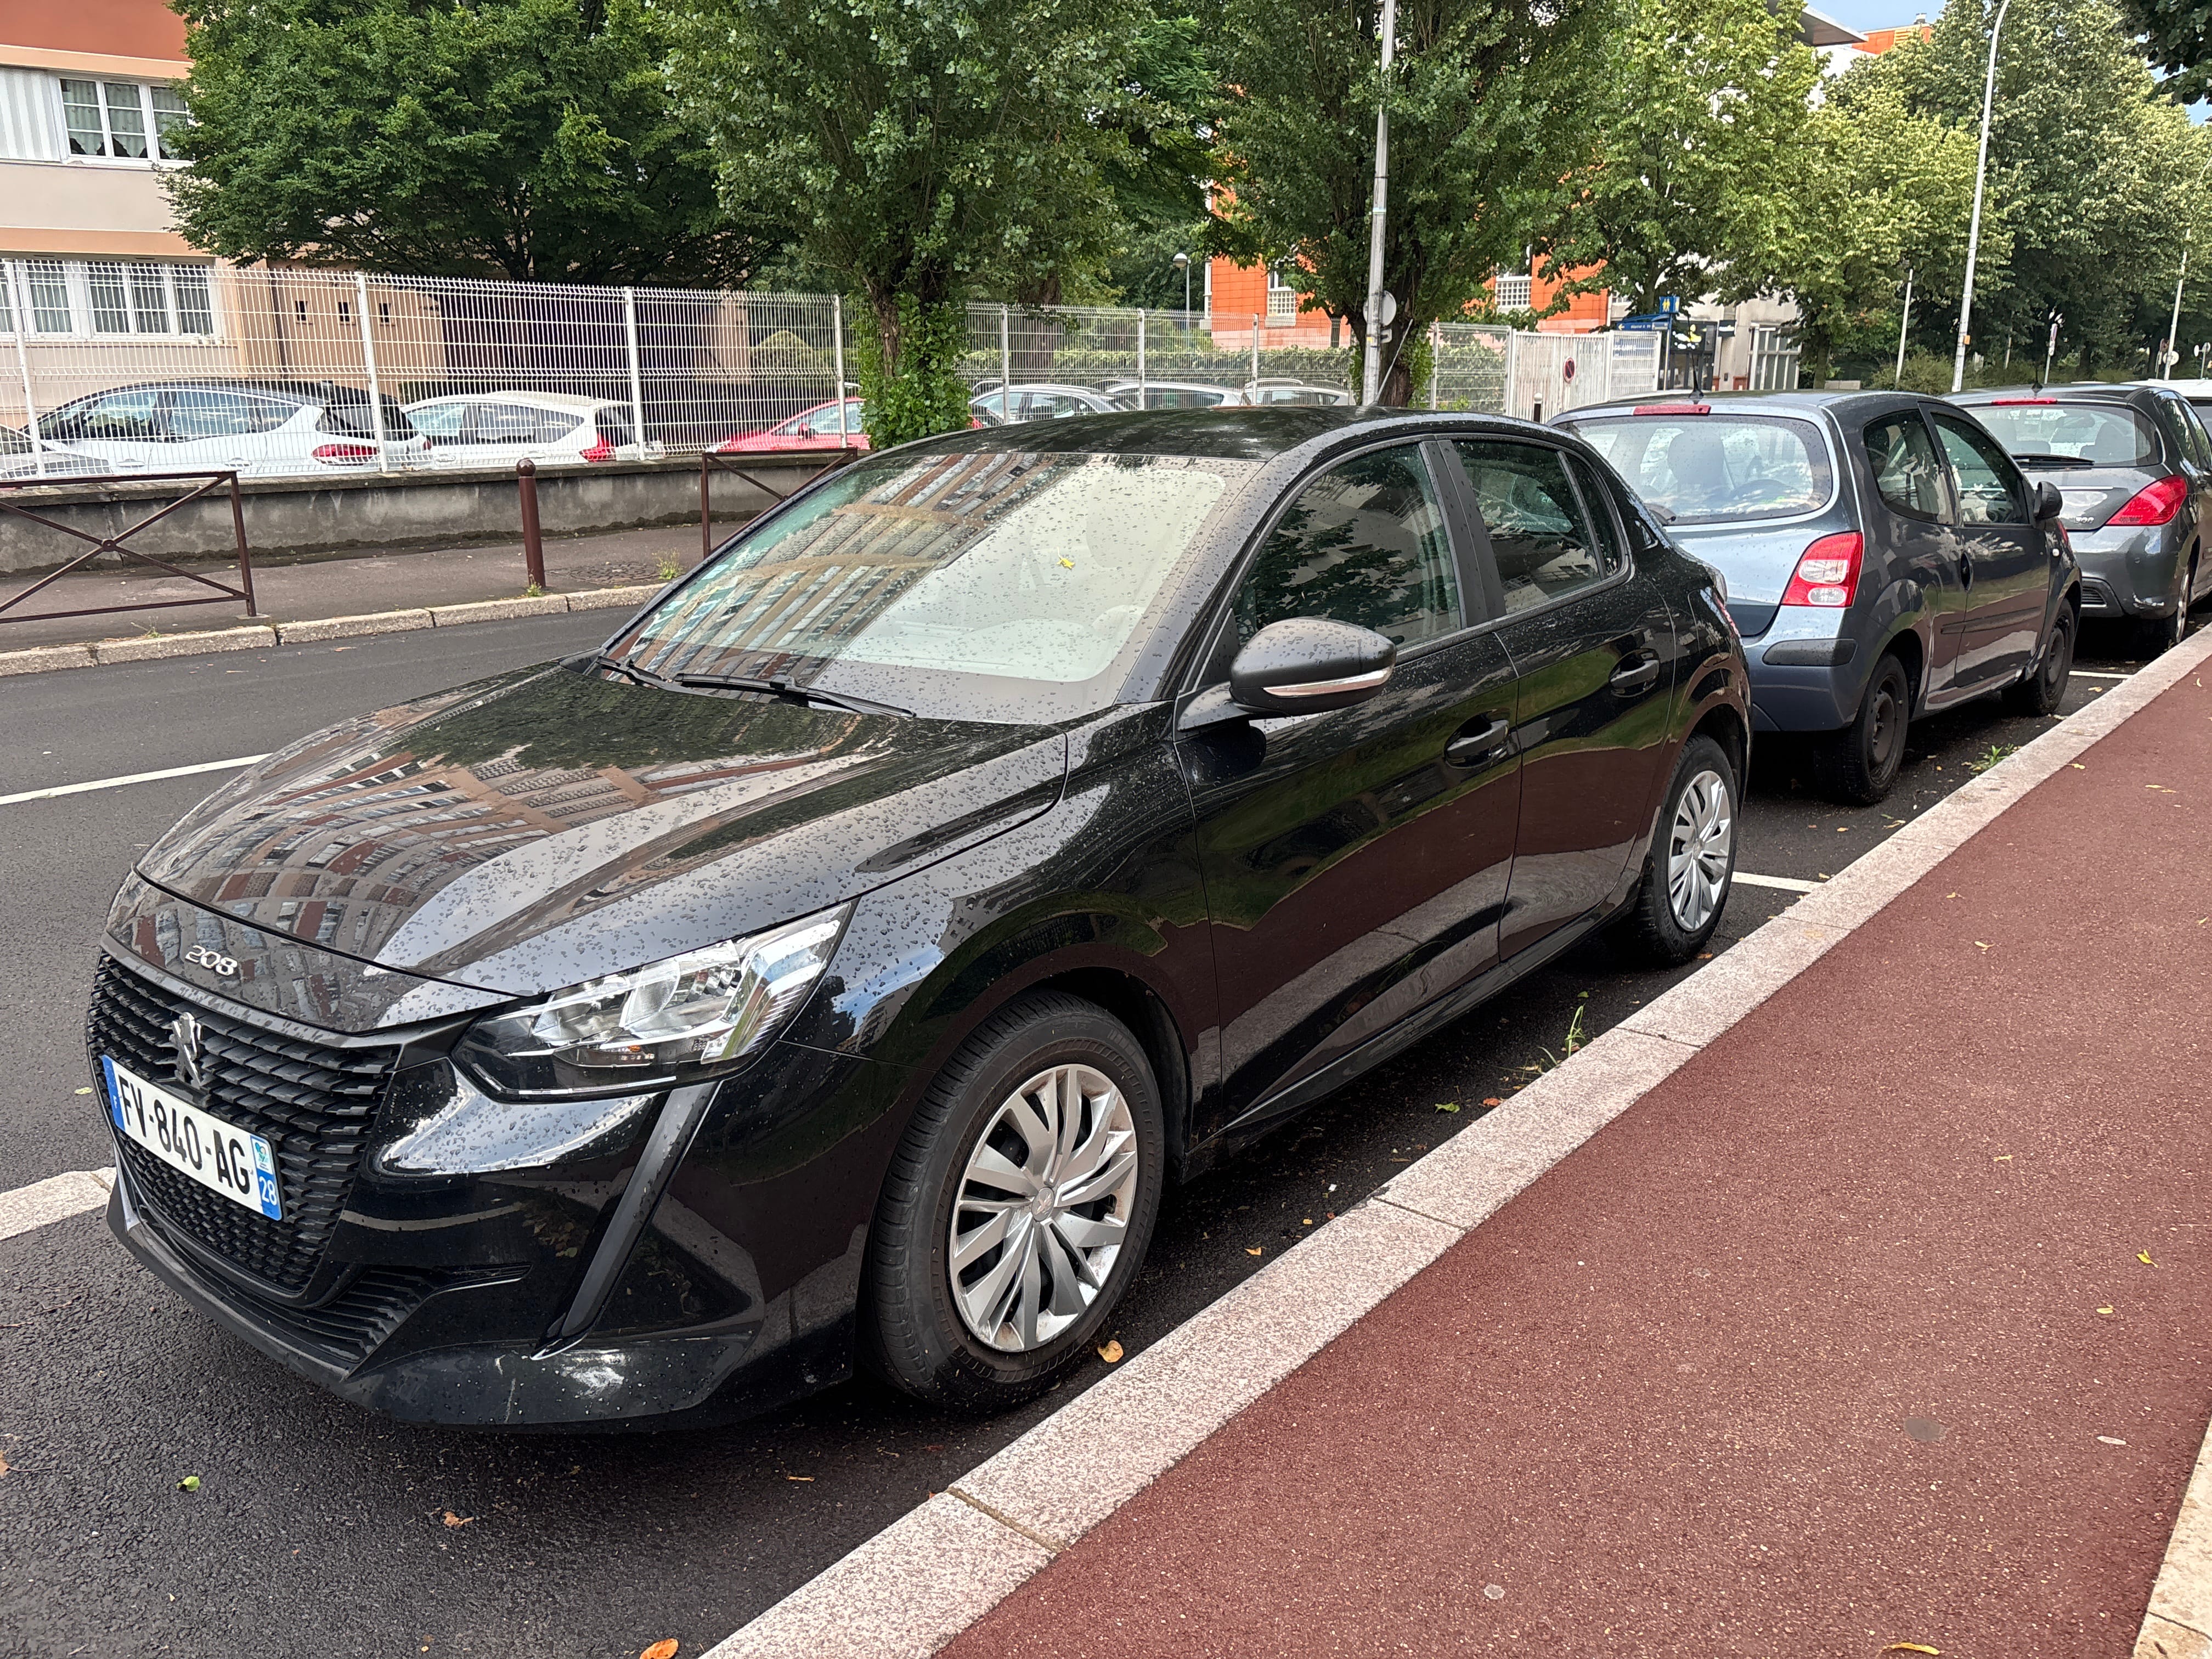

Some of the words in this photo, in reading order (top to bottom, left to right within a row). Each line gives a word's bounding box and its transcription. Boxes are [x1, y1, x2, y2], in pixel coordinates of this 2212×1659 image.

[185, 945, 238, 976] 208
[118, 1074, 251, 1195] FV-840-AG
[259, 1176, 277, 1206] 28
